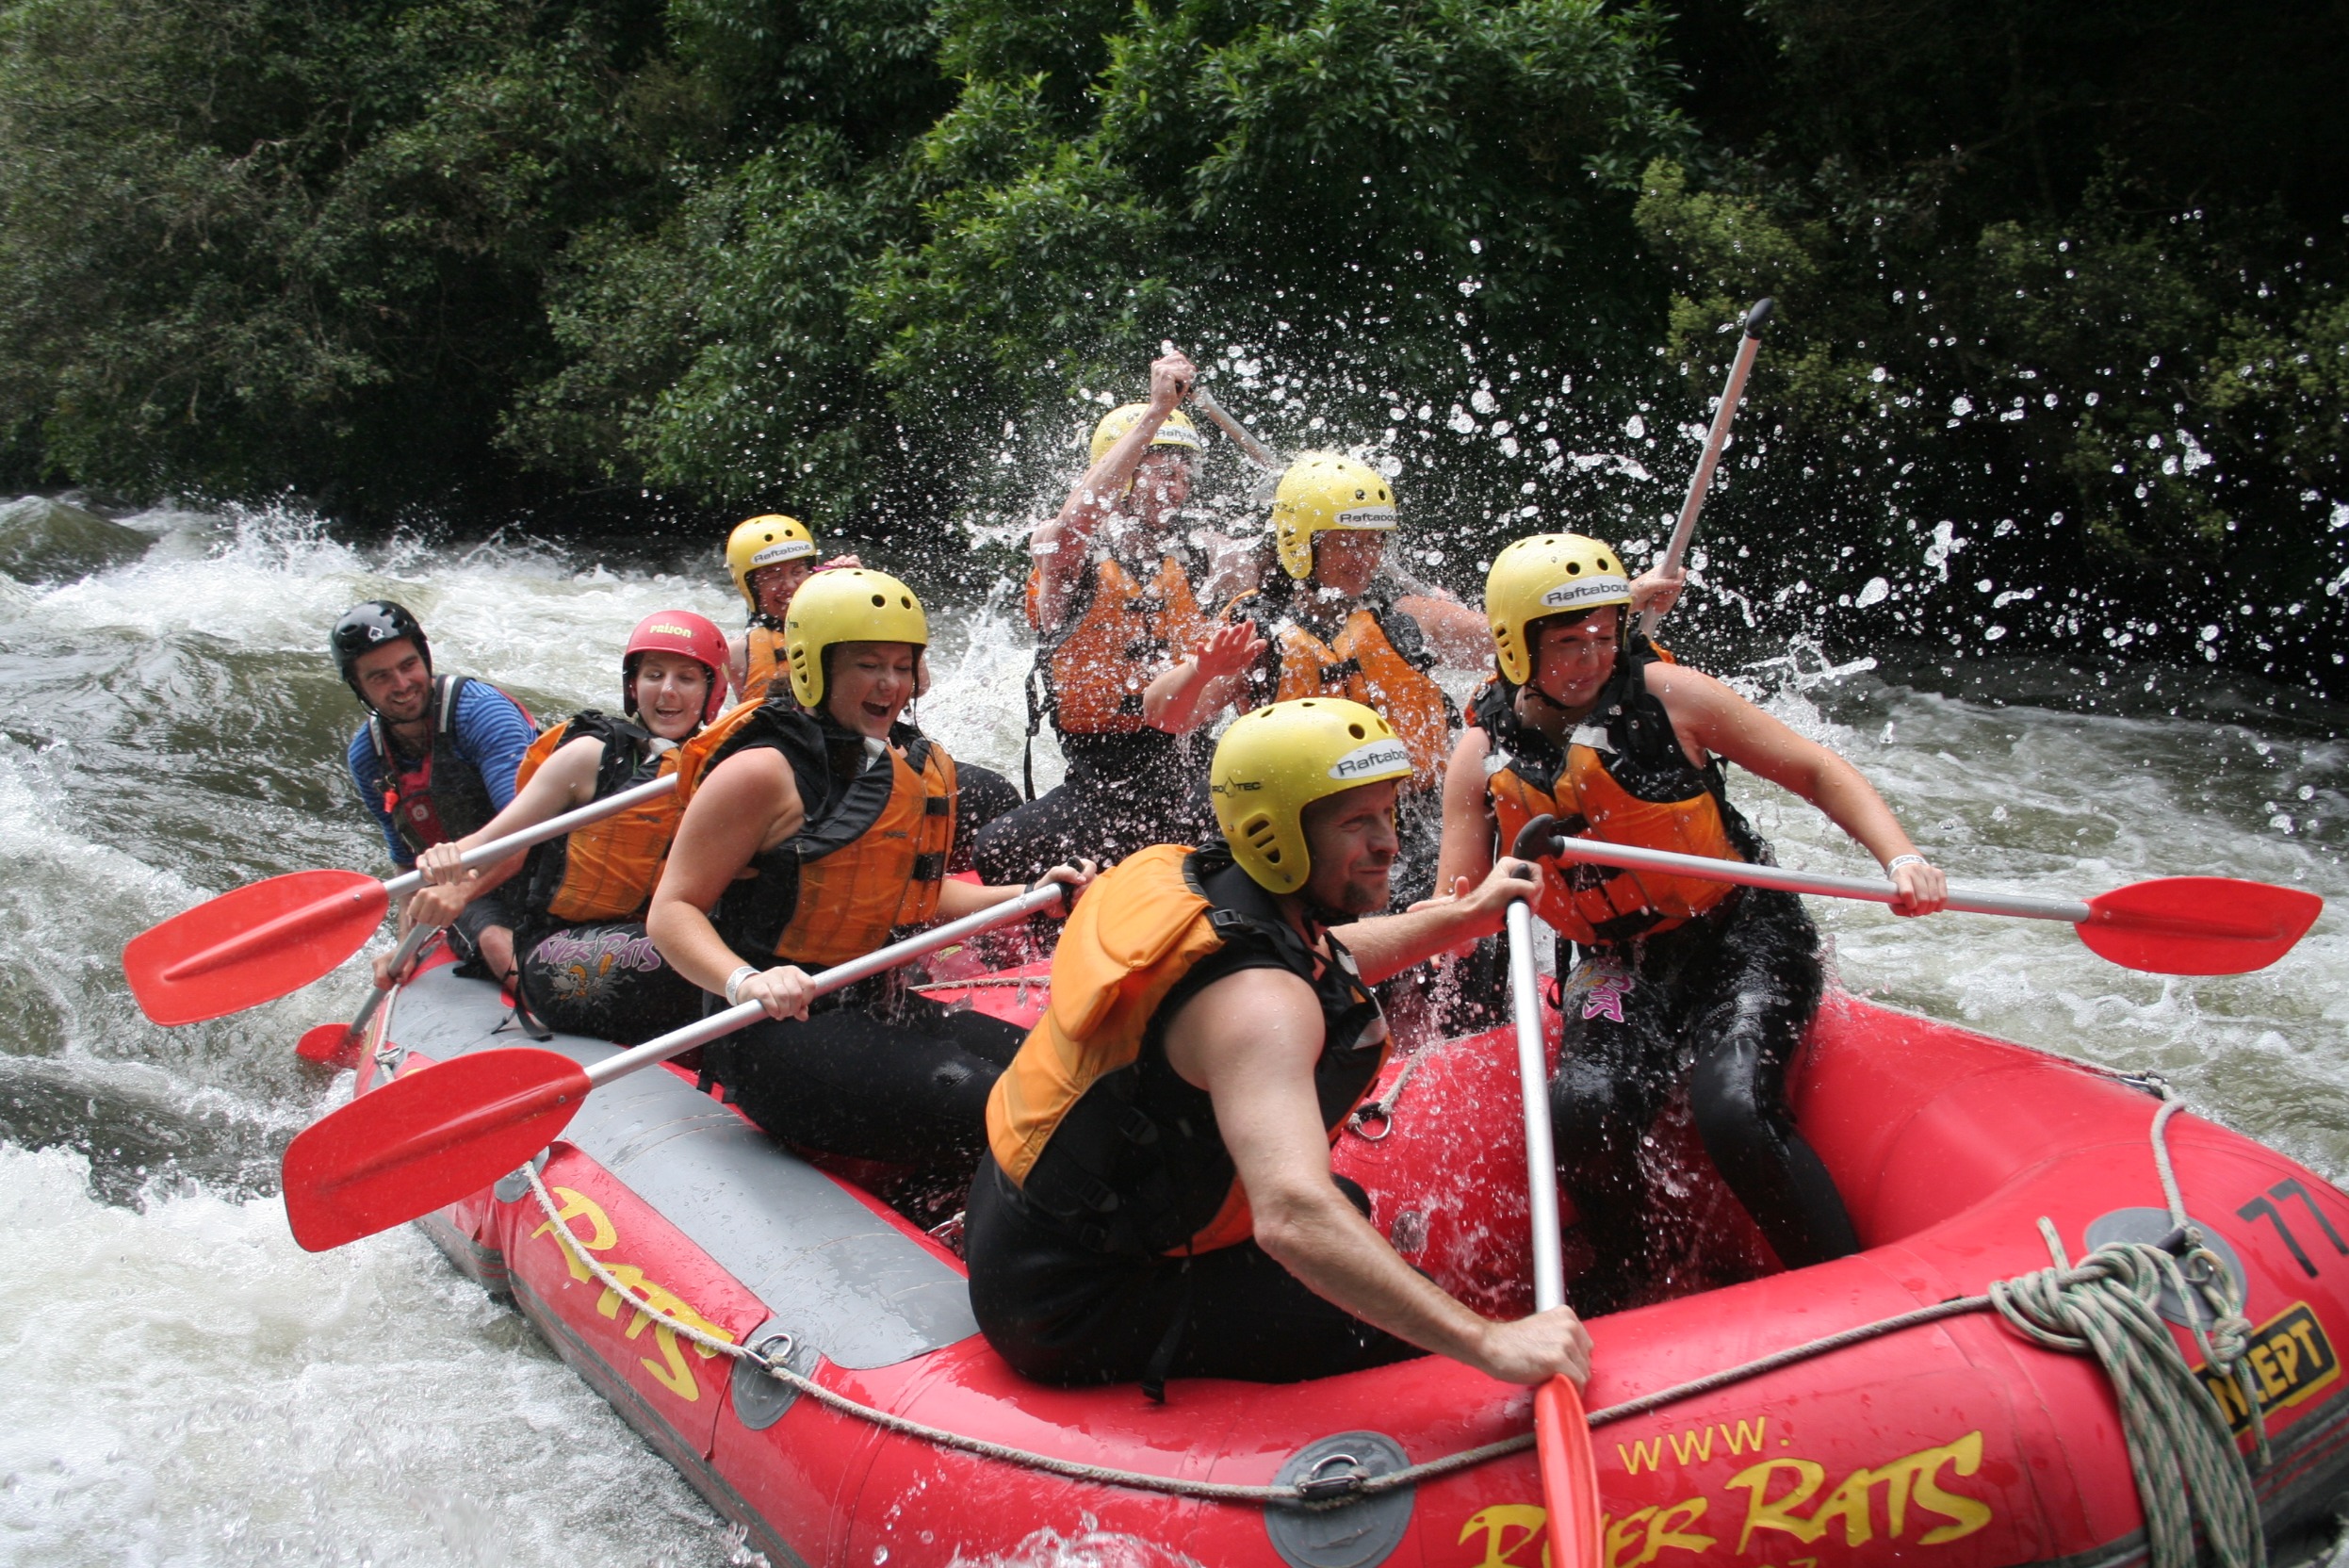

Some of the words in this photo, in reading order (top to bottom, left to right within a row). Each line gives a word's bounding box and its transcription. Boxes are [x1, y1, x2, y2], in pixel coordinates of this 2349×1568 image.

[2236, 1177, 2349, 1279] 77
[2207, 1319, 2324, 1425] NEPT
[1458, 1496, 1718, 1568] RER
[1725, 1430, 1992, 1556] RATS
